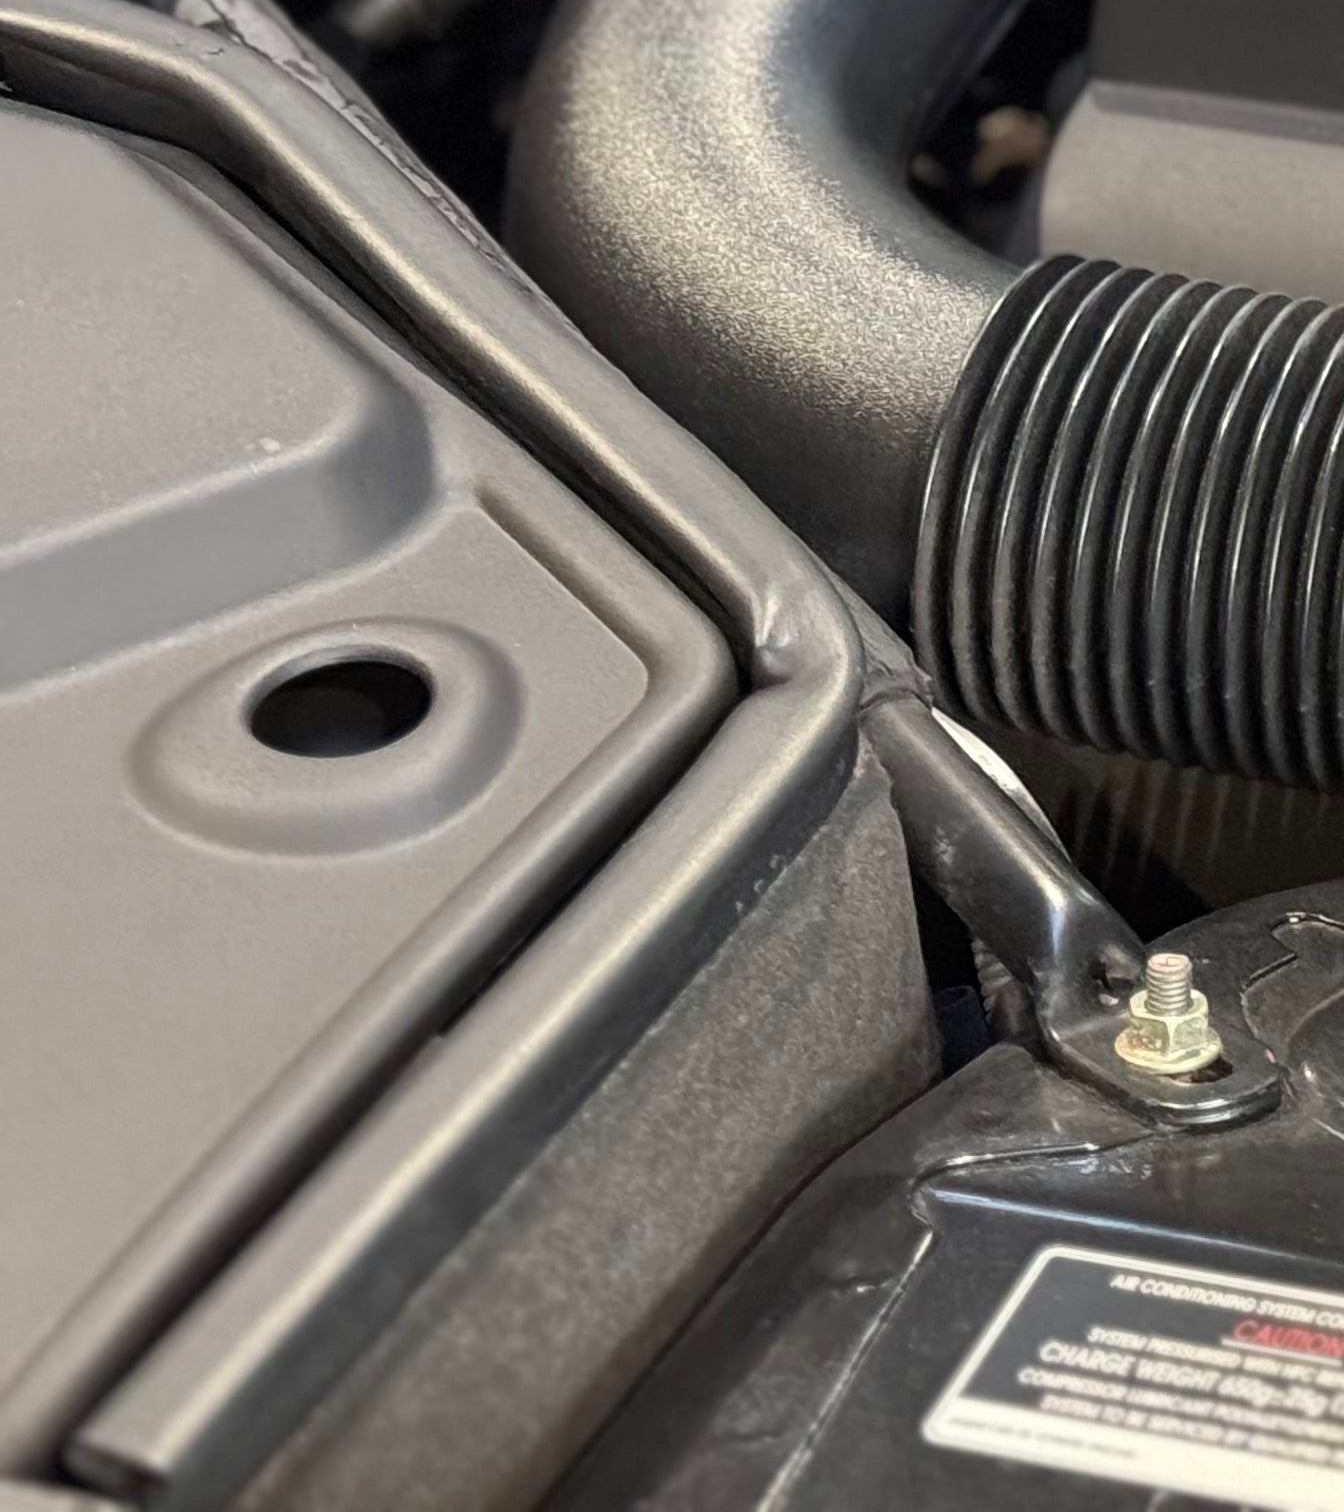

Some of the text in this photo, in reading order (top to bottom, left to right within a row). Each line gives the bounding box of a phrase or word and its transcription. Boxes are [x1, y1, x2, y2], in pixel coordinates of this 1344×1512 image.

[1111, 1274, 1140, 1291] AIR
[1140, 1280, 1255, 1312] CONDITIONING
[1256, 1301, 1314, 1323] SYSTEM
[1038, 1342, 1134, 1377] CHARGE
[1133, 1358, 1220, 1393] WEIGHT
[1087, 1327, 1145, 1351] SYSTEM
[1243, 1355, 1278, 1376] WITH
[1018, 1367, 1125, 1401] COMPRESSOR
[1126, 1387, 1212, 1418] LUBRICANT
[1041, 1395, 1100, 1419] SYSTEM
[1101, 1406, 1124, 1424] TO
